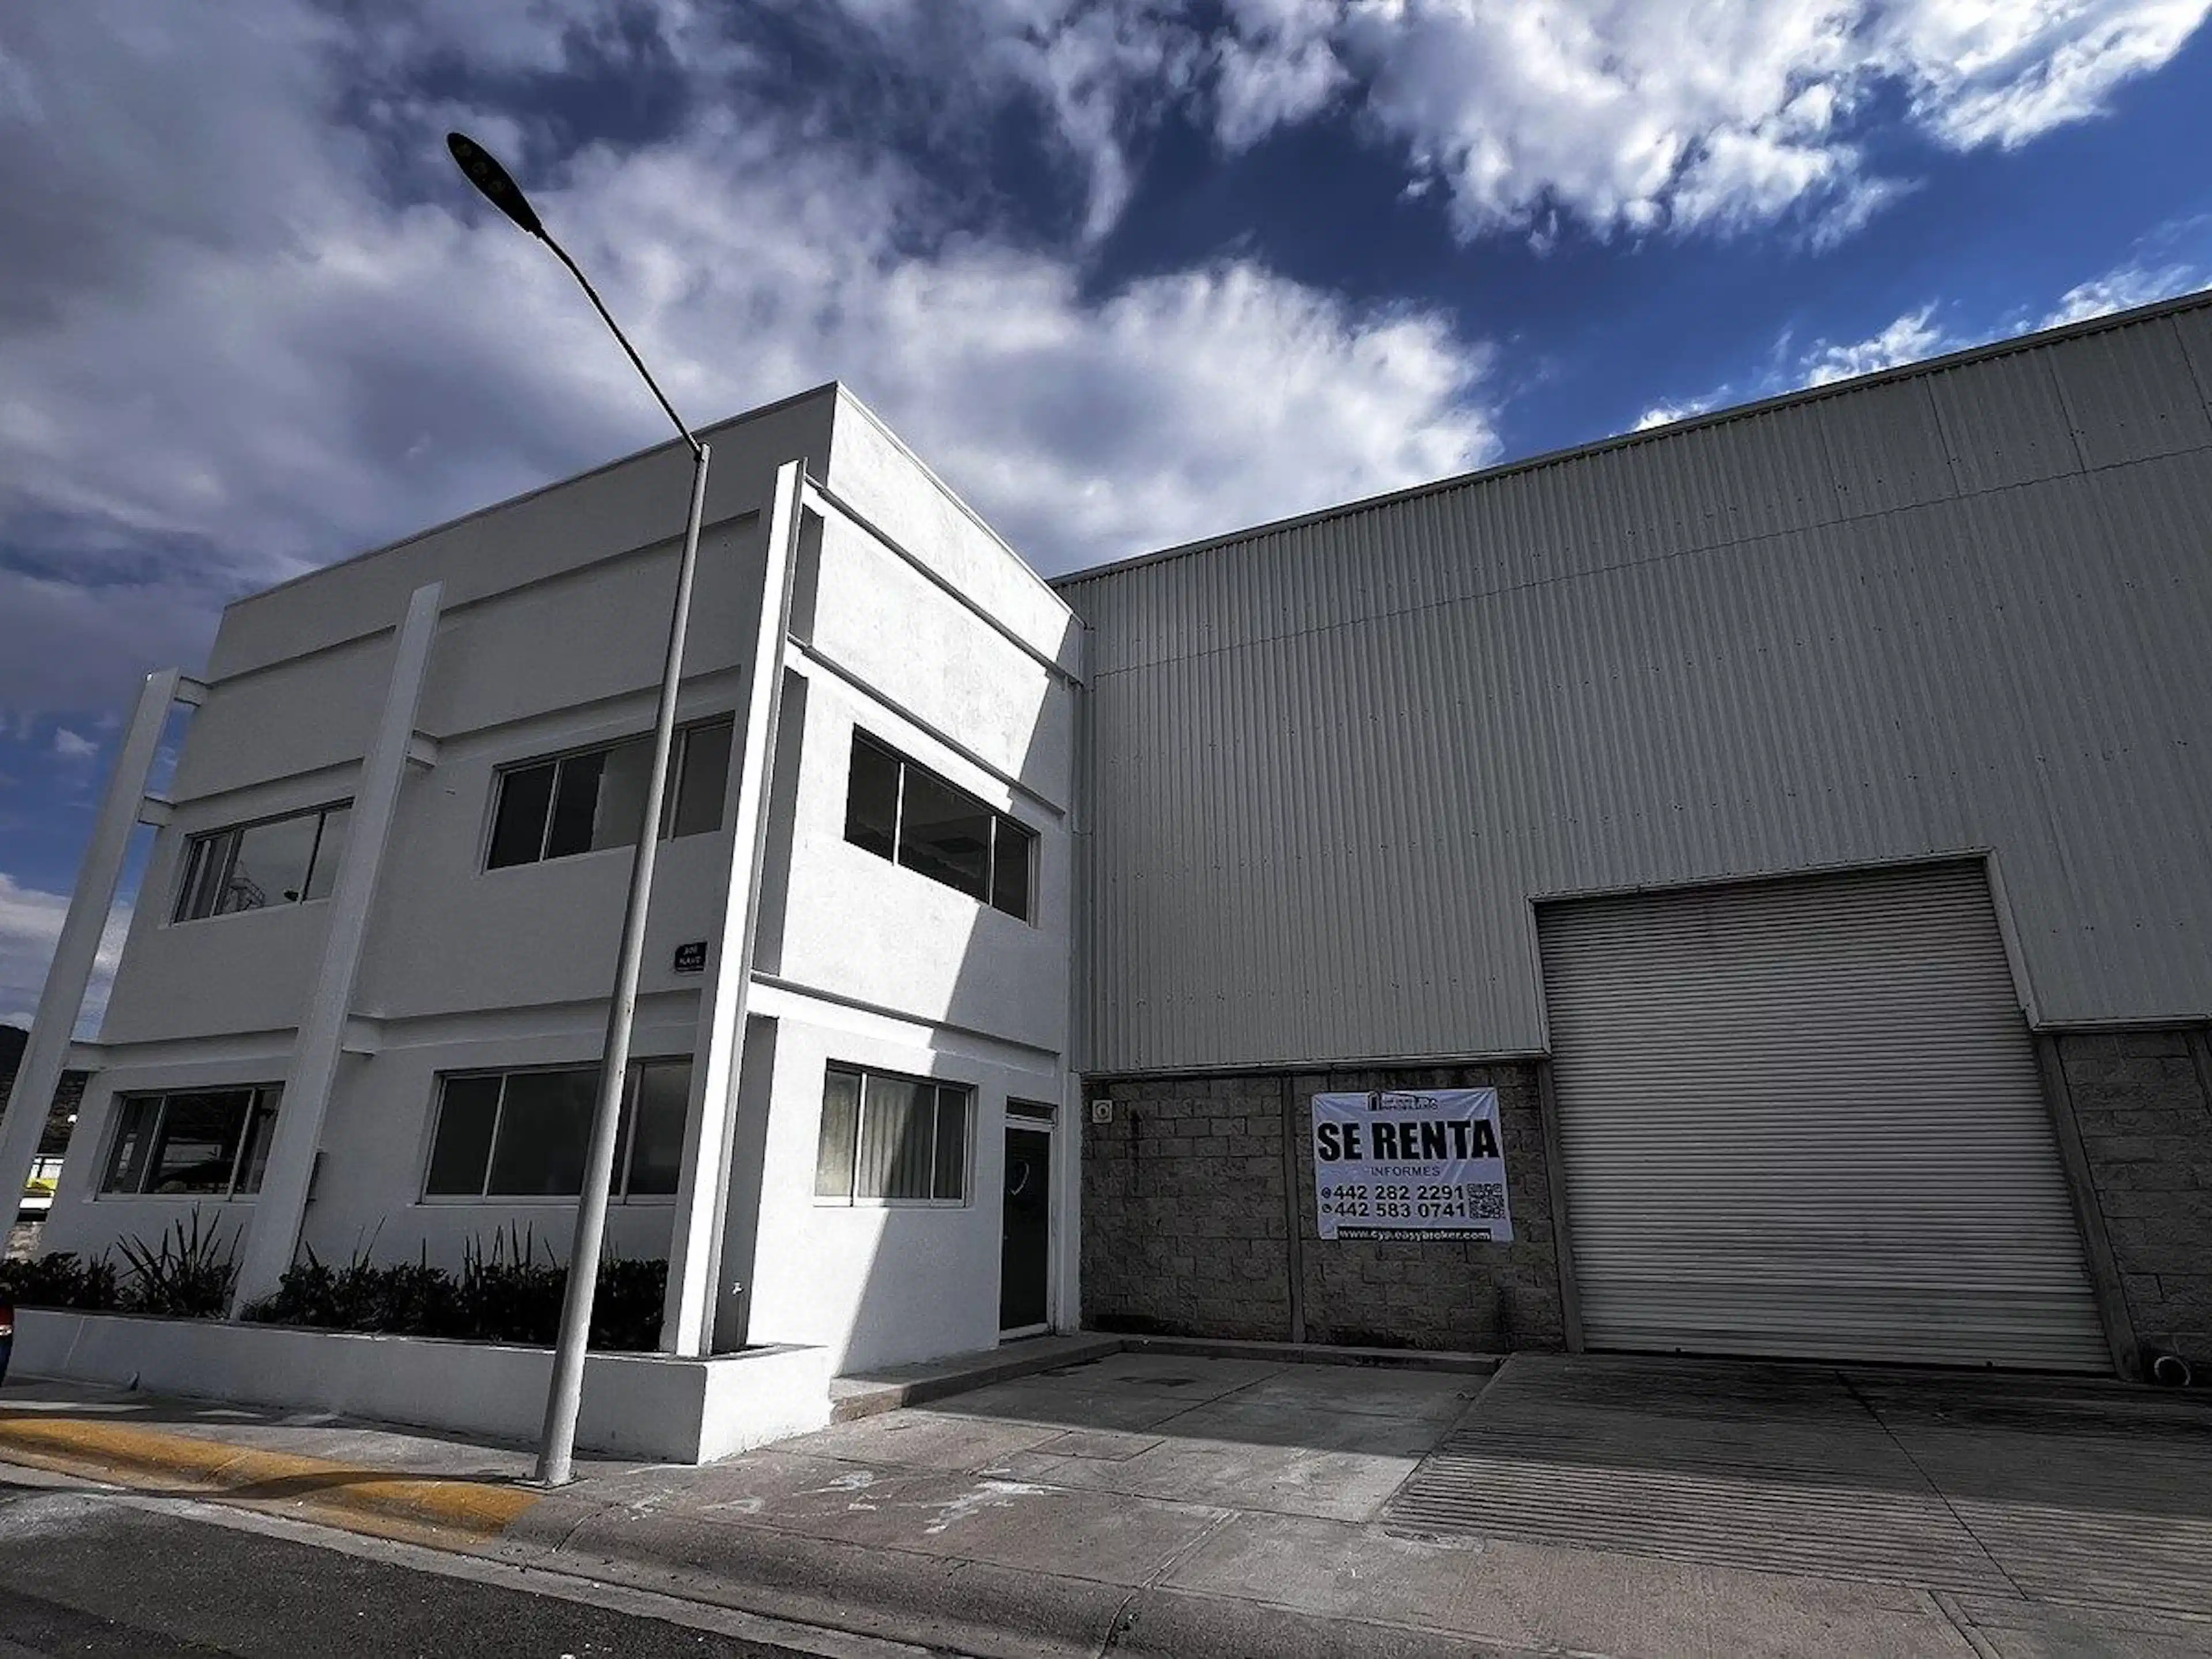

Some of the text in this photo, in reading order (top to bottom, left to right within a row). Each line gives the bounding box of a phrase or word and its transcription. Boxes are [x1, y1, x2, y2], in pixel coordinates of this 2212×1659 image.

[1318, 1119, 1501, 1161] SE RENTA
[1371, 1165, 1440, 1177] INFORMES
[1334, 1185, 1463, 1199] 442 282 2291
[1335, 1203, 1464, 1217] 442 583 0741
